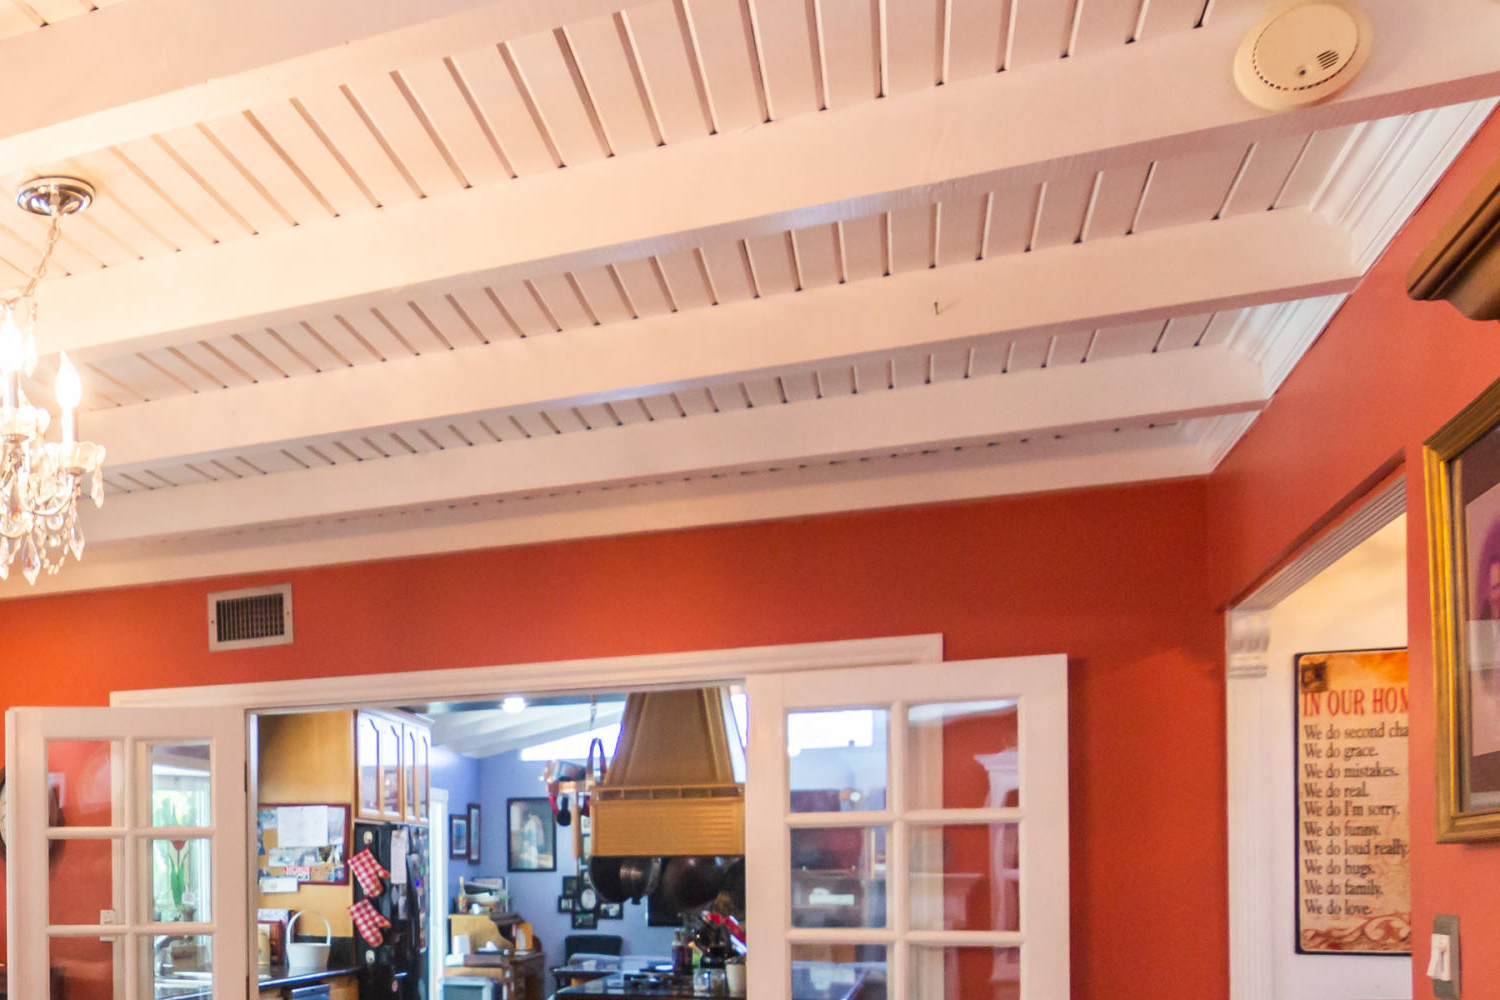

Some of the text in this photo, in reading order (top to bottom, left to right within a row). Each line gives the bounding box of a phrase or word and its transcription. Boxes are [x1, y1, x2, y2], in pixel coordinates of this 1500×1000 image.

[1303, 691, 1320, 717] IN
[1327, 689, 1365, 716] OUR
[1303, 724, 1323, 740] We
[1325, 723, 1340, 740] do
[1344, 721, 1385, 739] second
[1303, 742, 1379, 761] We do grace.
[1303, 761, 1400, 778] We do mistakes.
[1303, 781, 1370, 798] We do real.
[1303, 801, 1323, 816] We
[1325, 800, 1340, 816] do
[1344, 800, 1364, 816] I'm
[1303, 821, 1323, 836] We
[1325, 820, 1340, 836] do
[1303, 840, 1323, 855] We
[1325, 839, 1340, 855] do
[1344, 839, 1371, 855] loud
[1303, 858, 1376, 878] We do hugs.
[1303, 878, 1384, 898] We do family.
[1303, 898, 1373, 915] We do love.
